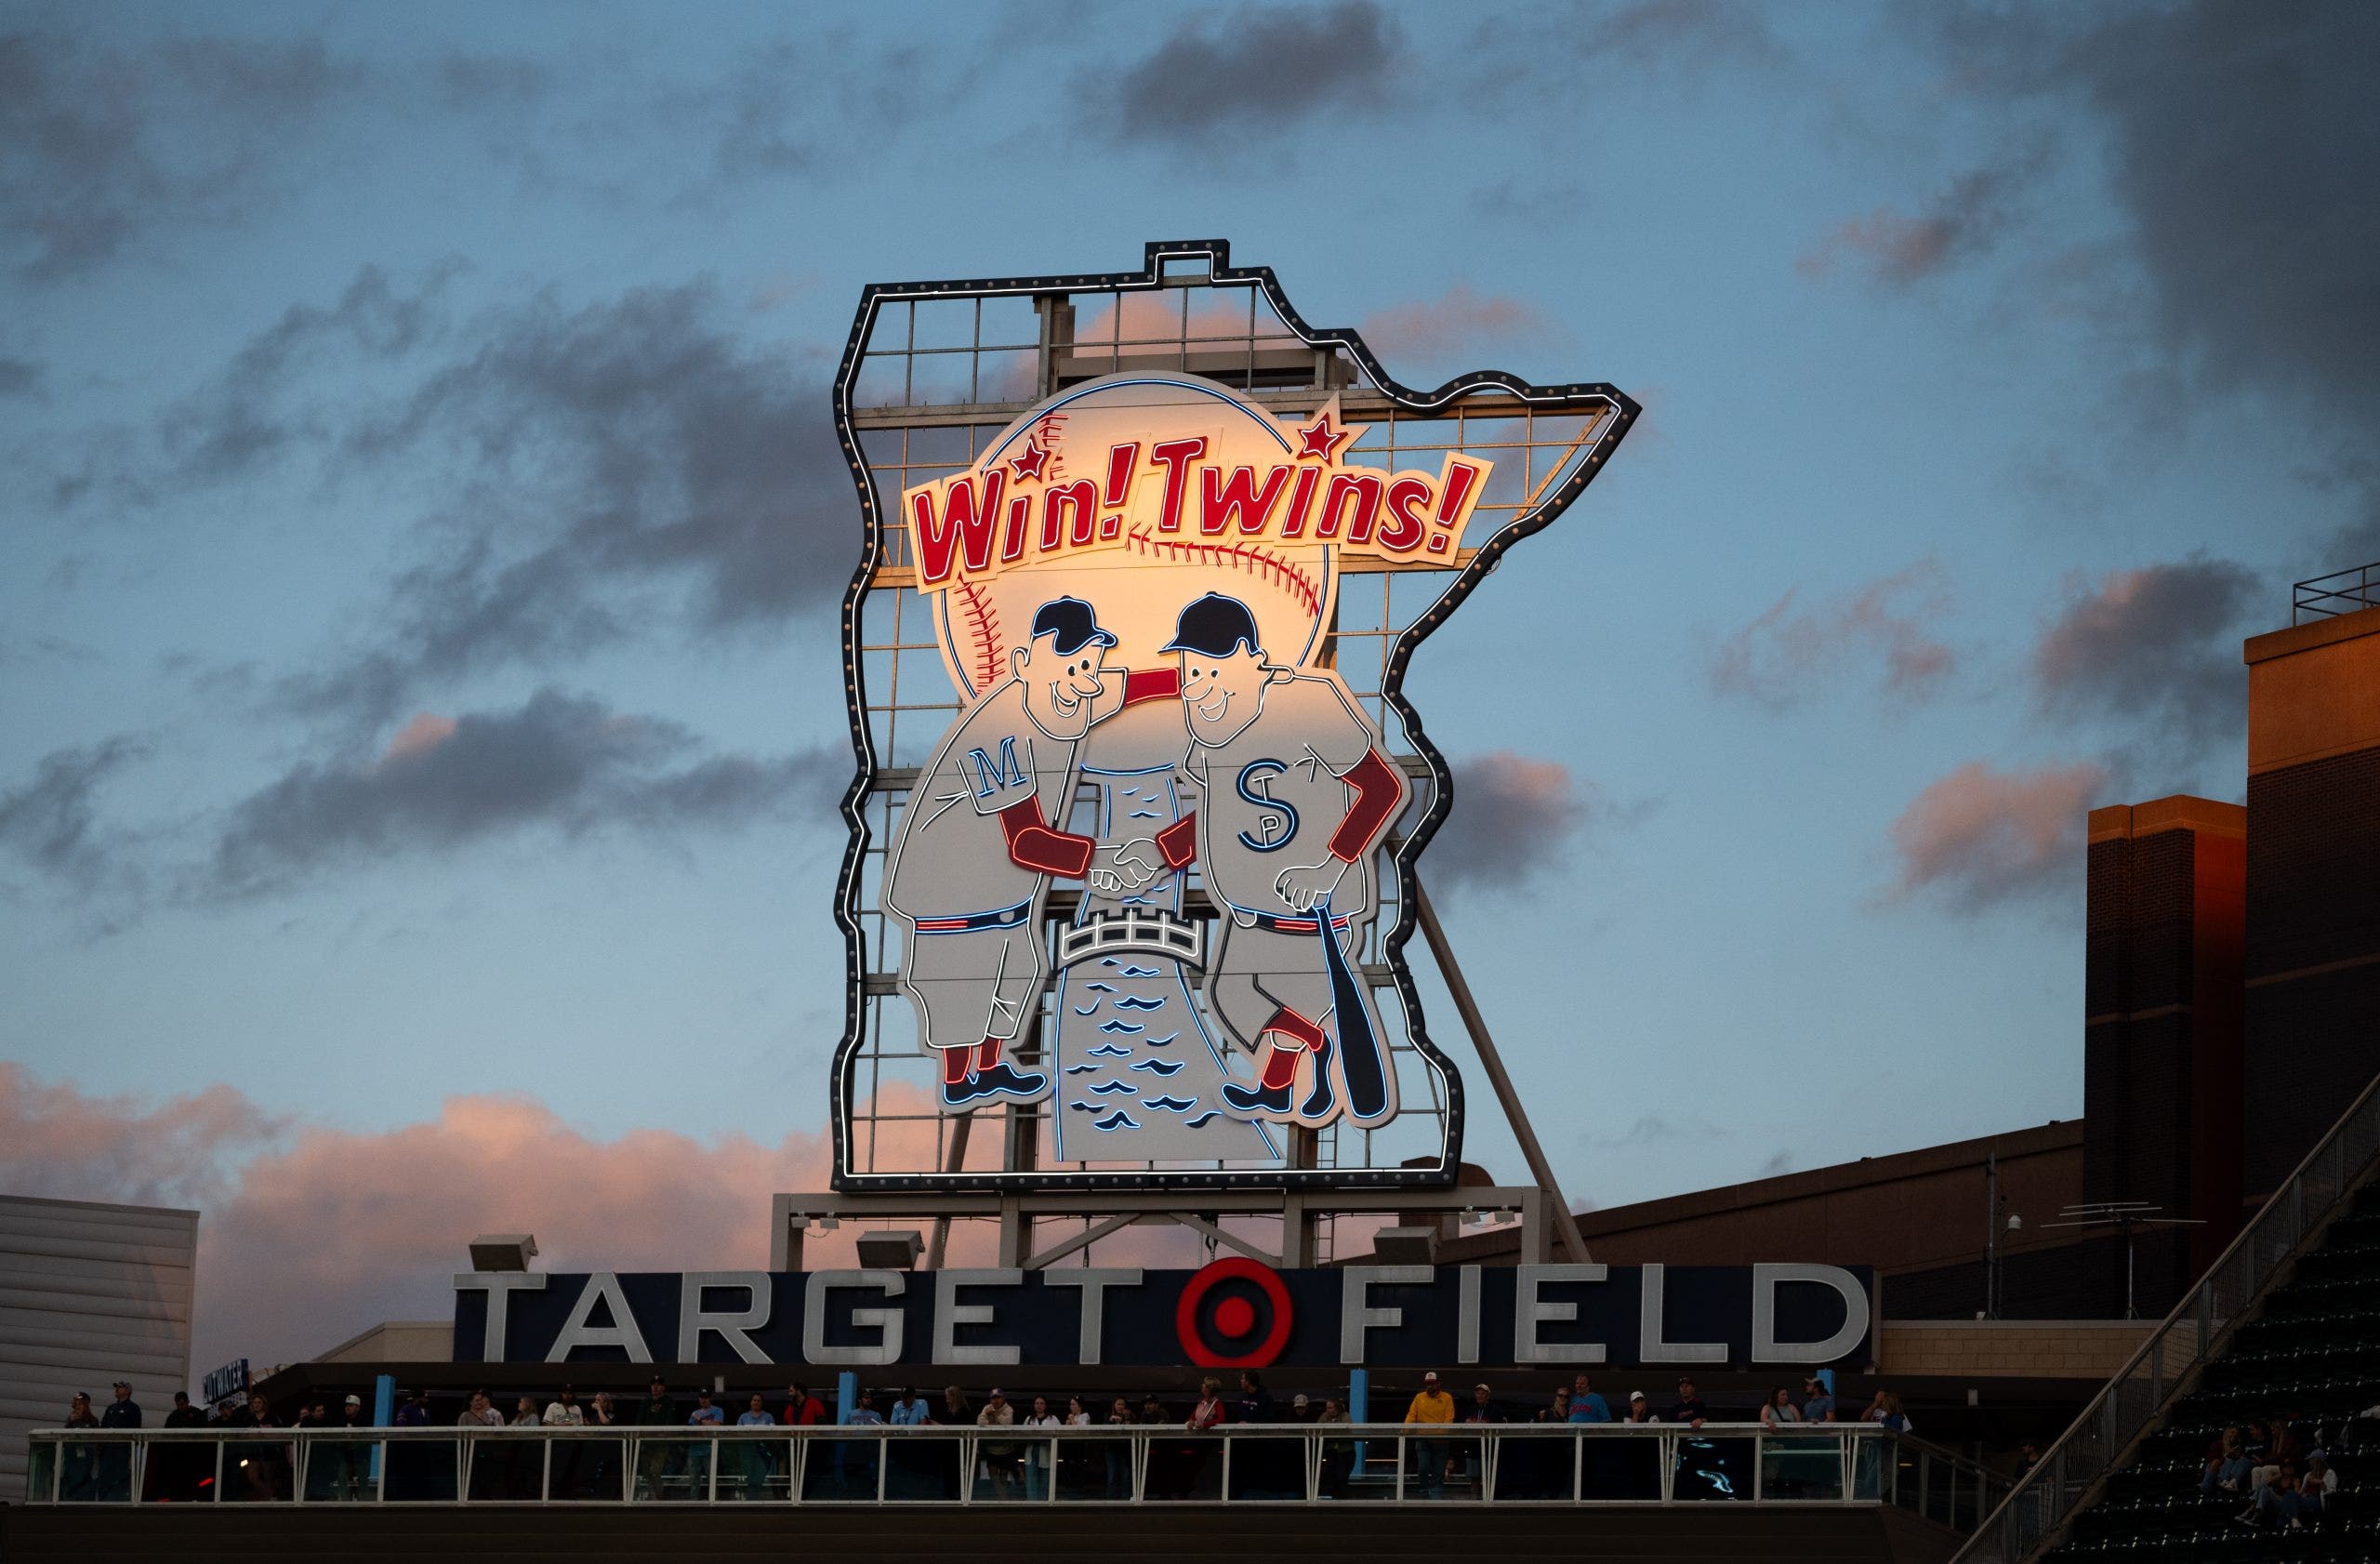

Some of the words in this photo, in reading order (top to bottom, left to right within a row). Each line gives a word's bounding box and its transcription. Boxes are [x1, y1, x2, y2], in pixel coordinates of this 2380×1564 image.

[912, 438, 1141, 584] Win!
[1152, 412, 1478, 554] Twins!
[968, 736, 1028, 797] M
[453, 1268, 1144, 1365] TARGET
[1340, 1263, 1870, 1364] FIELD
